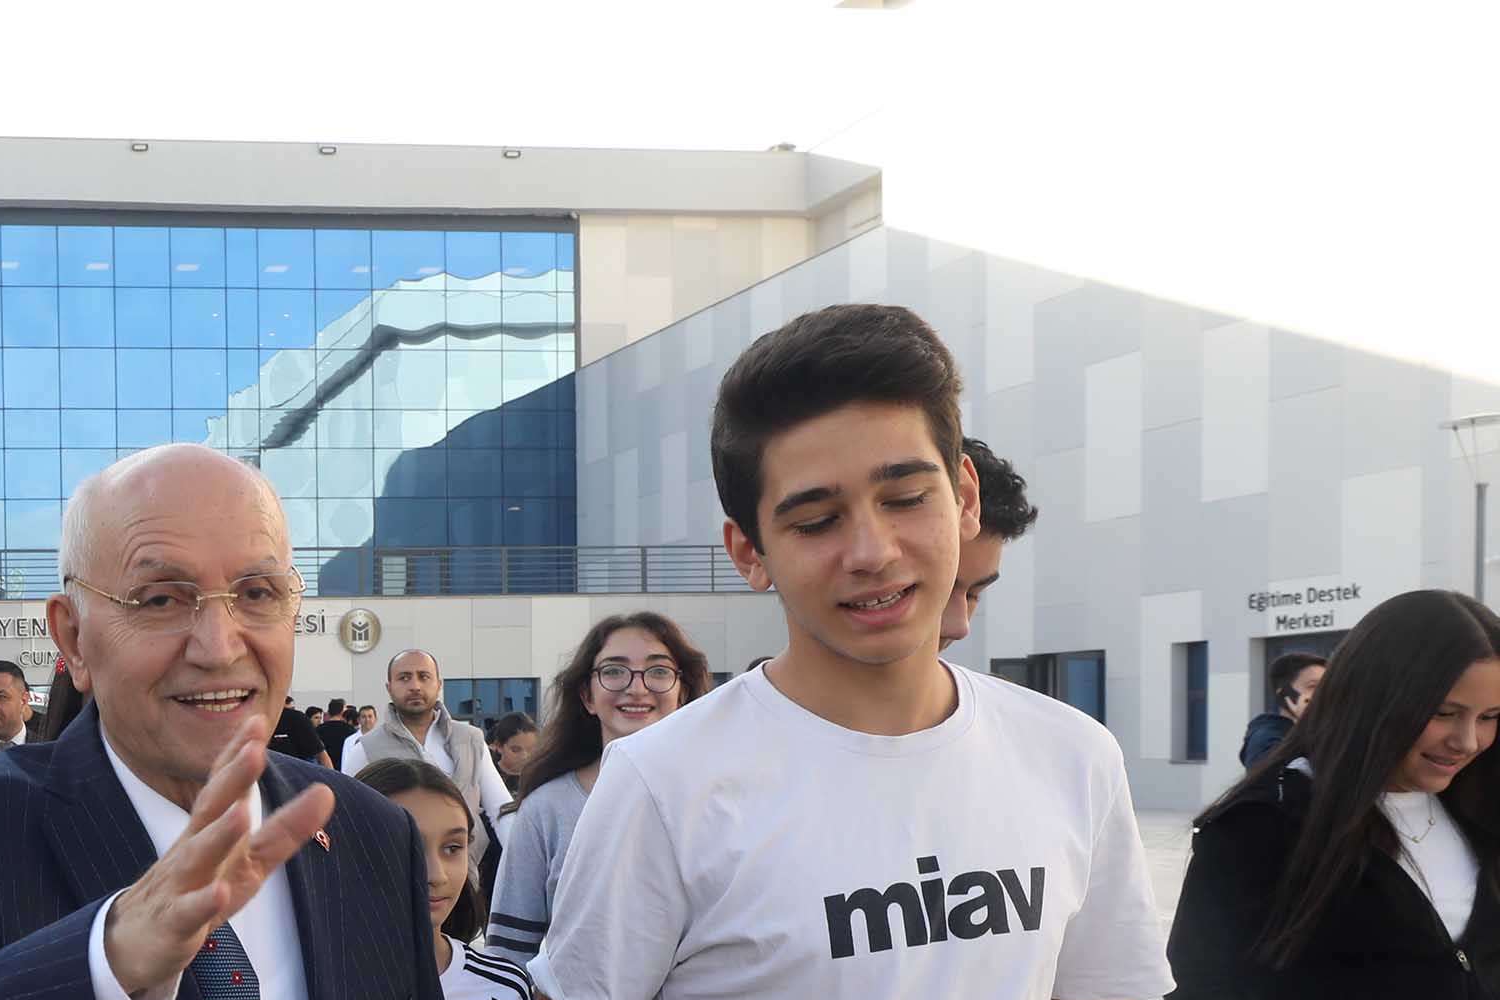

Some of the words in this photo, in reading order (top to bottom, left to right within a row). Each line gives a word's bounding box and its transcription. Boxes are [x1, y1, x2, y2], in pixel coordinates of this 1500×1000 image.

[1248, 591, 1302, 612] Eğitime
[1307, 582, 1361, 604] Destek
[295, 609, 326, 633] ESİ
[1275, 609, 1334, 631] Merkezi
[19, 650, 61, 667] CUM
[823, 855, 1046, 960] miav
